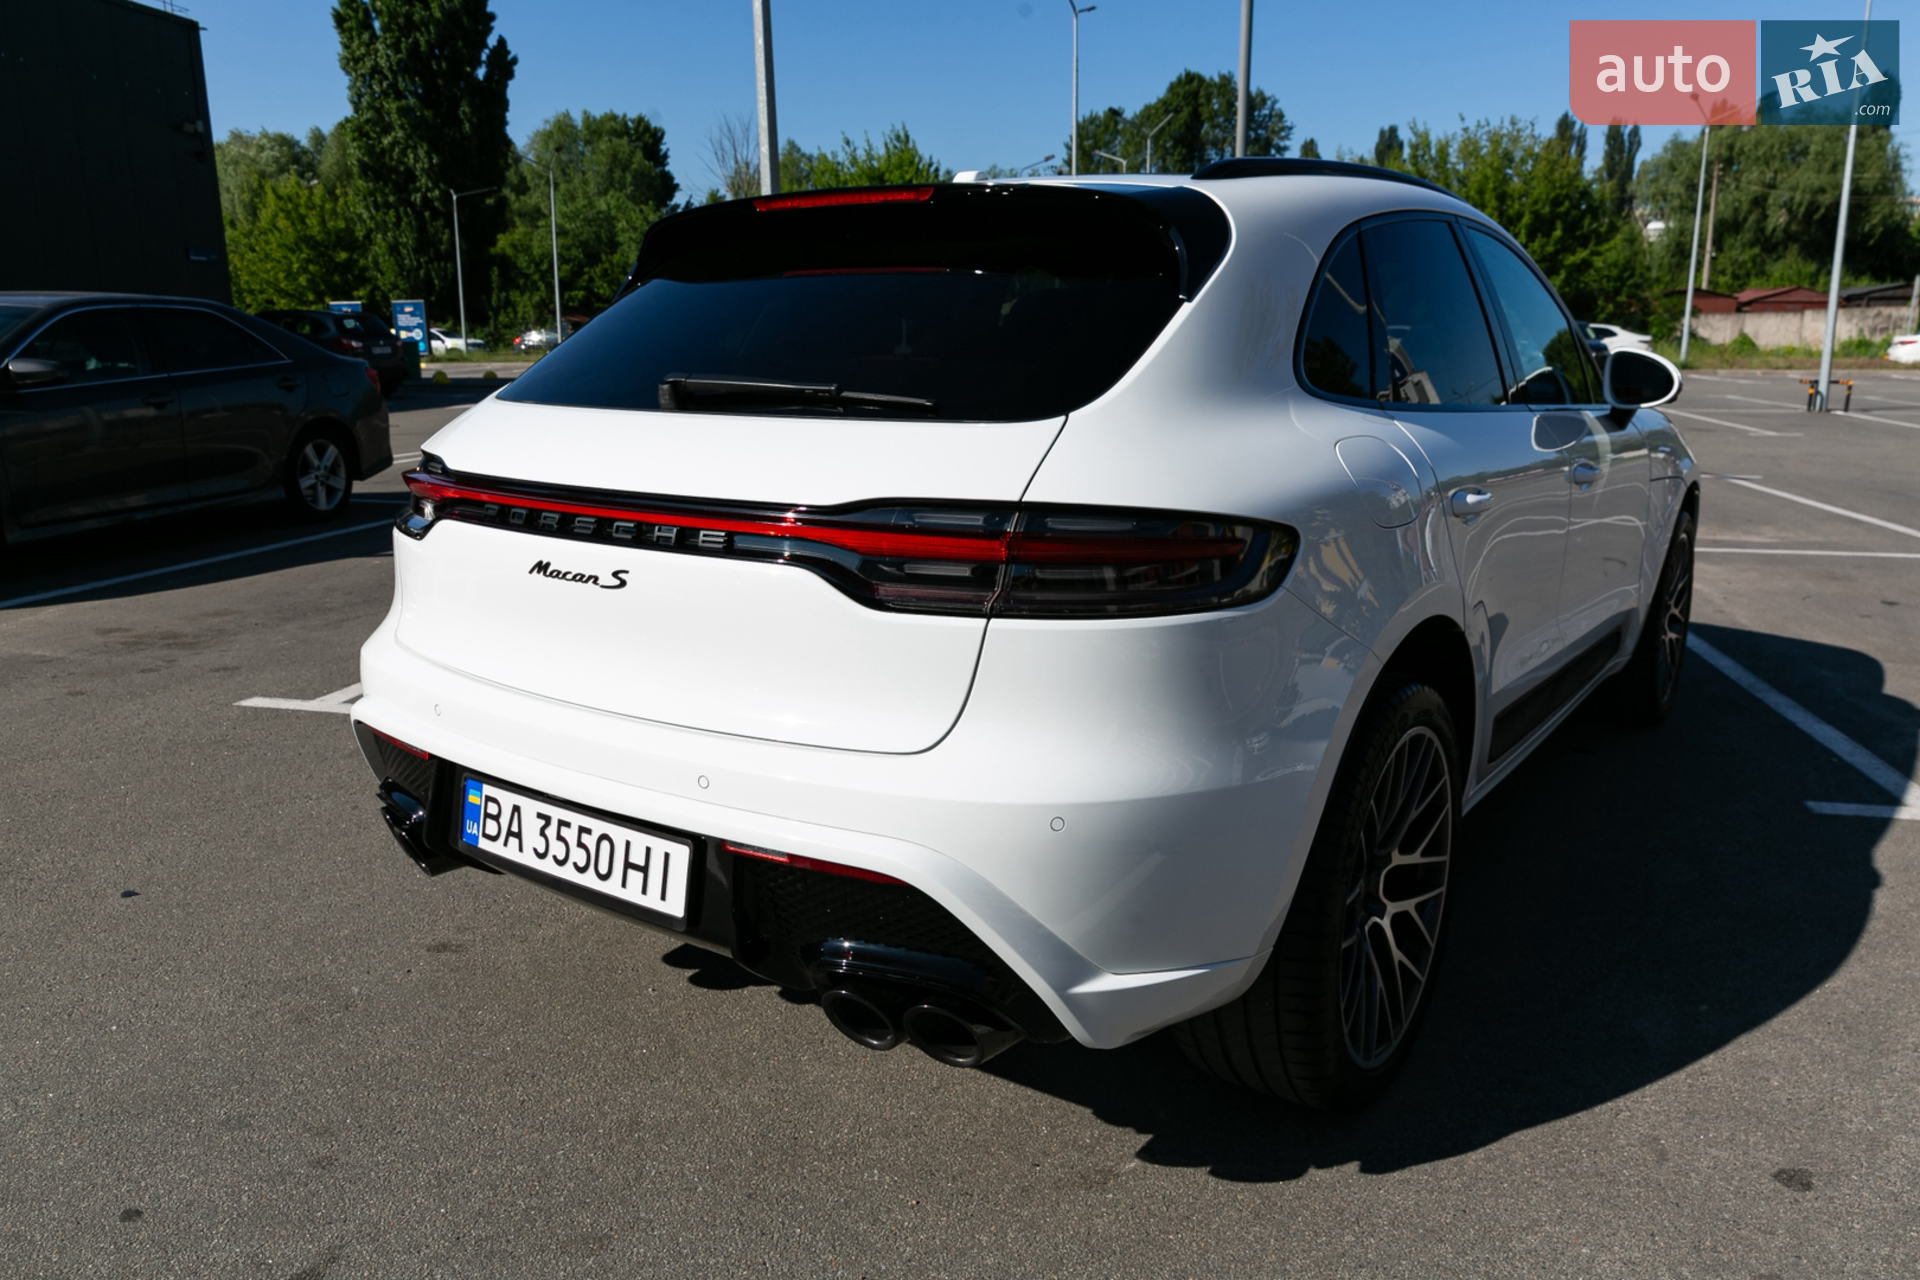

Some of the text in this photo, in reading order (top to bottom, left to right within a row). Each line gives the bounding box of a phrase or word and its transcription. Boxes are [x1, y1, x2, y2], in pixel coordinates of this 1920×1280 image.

[483, 503, 728, 548] PORSCHE
[528, 559, 630, 589] Macan S
[466, 819, 479, 837] UA
[481, 794, 671, 902] BA 3550 HI
